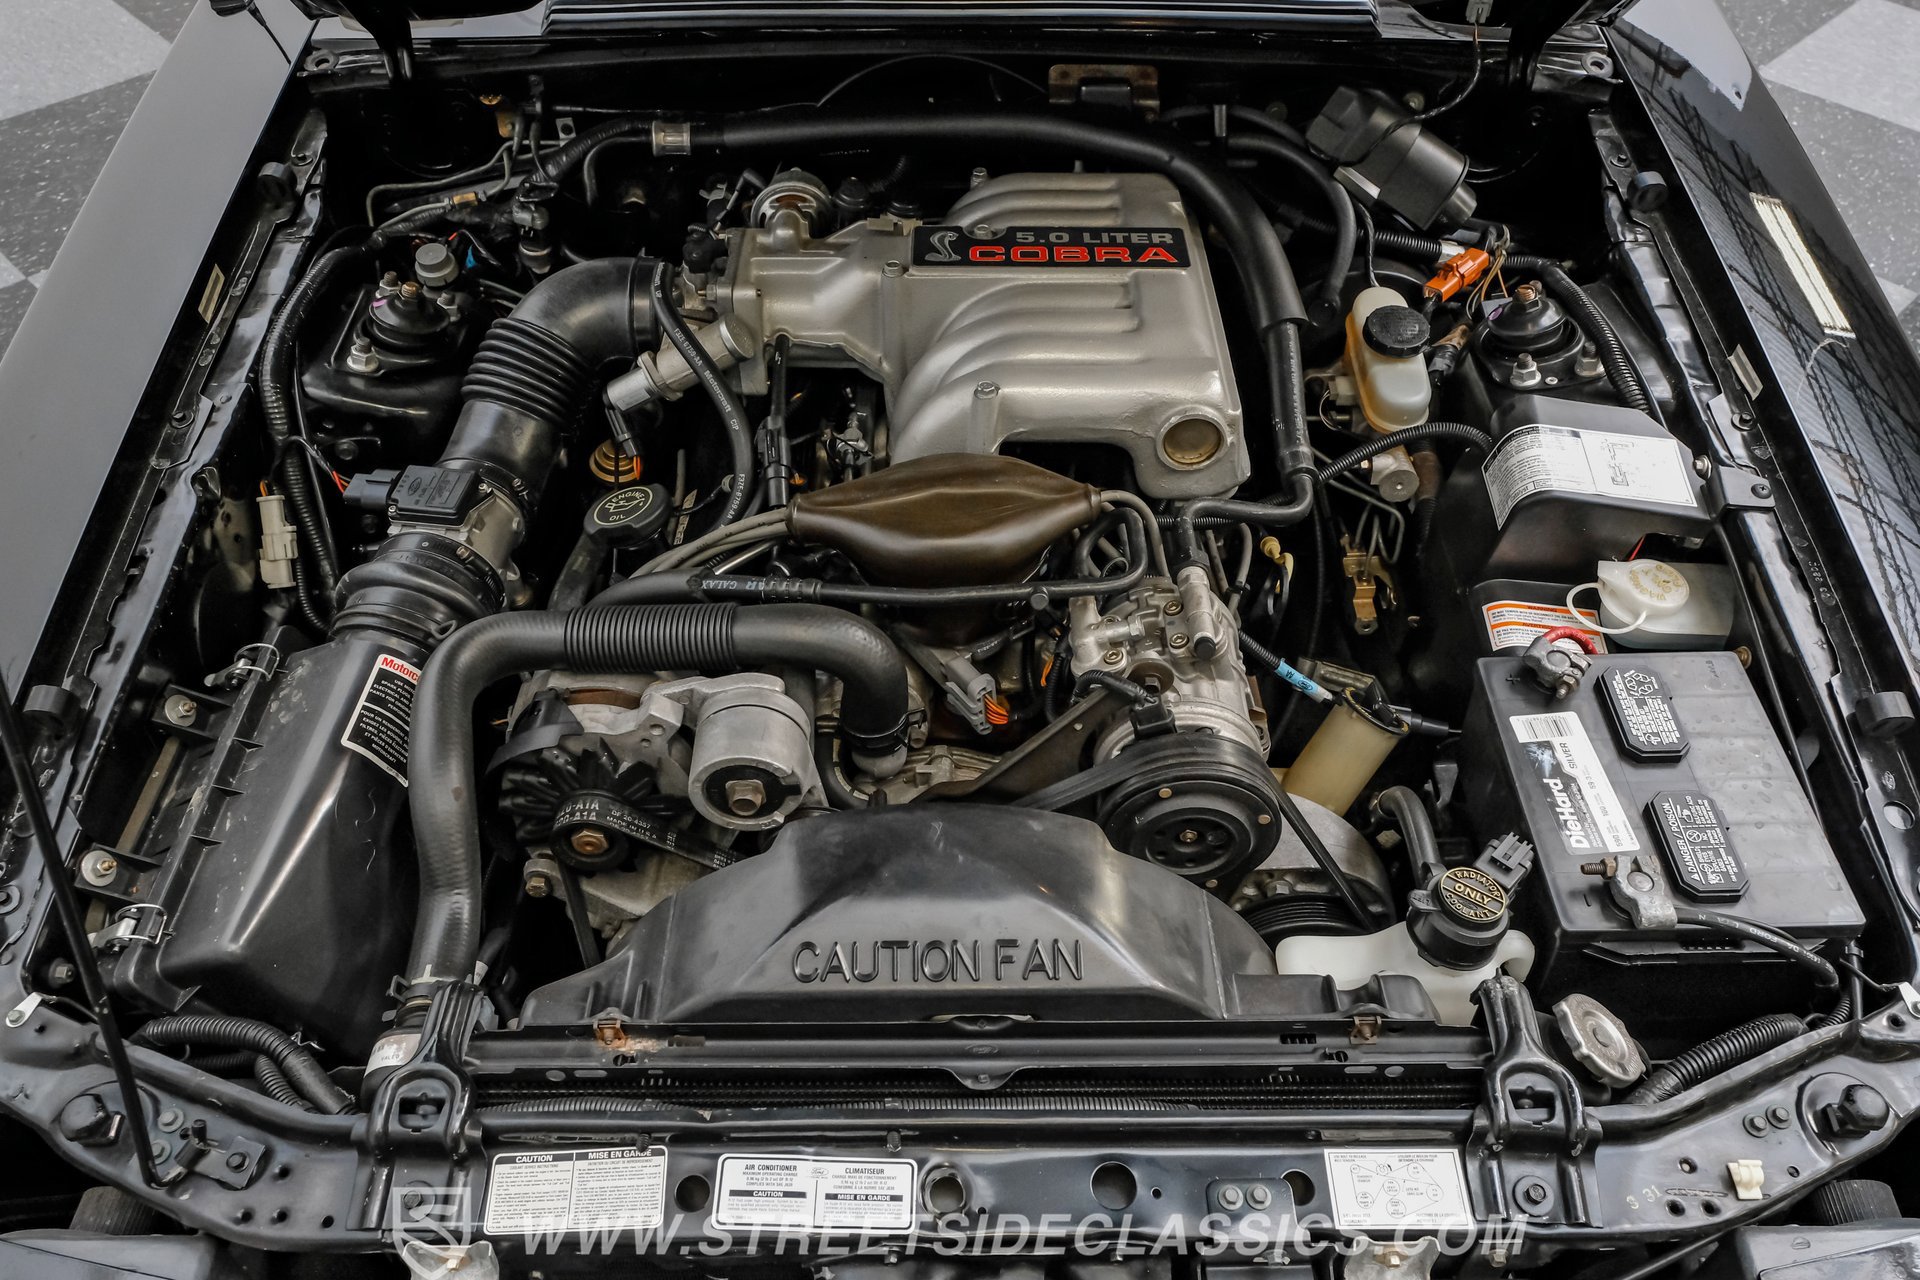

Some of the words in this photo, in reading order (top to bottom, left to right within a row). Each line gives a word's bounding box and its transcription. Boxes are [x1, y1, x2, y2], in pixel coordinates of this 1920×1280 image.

[1015, 231, 1069, 244] 5.0
[1083, 232, 1174, 244] LITER
[969, 245, 1179, 263] COBRA
[703, 369, 732, 413] Motorcraft
[611, 491, 646, 502] ENGINE
[381, 656, 421, 681] Motorc
[372, 743, 397, 763] MOTORCRAFT
[1560, 743, 1578, 769] SILVER
[1542, 778, 1590, 849] DieHard
[1658, 801, 1682, 832] POISON
[1700, 832, 1708, 840] NO
[1673, 839, 1700, 872] DANGER
[1455, 871, 1501, 897] RADIATOR
[1455, 883, 1492, 905] ONLY
[1446, 893, 1491, 918] COOLANT
[1749, 927, 1778, 943] FORD
[792, 939, 982, 983] CAUTION
[995, 938, 1084, 981] FAN
[515, 1155, 553, 1163] CAUTION
[588, 1151, 609, 1159] MISE
[844, 1167, 885, 1175] CLIMATISEUR
